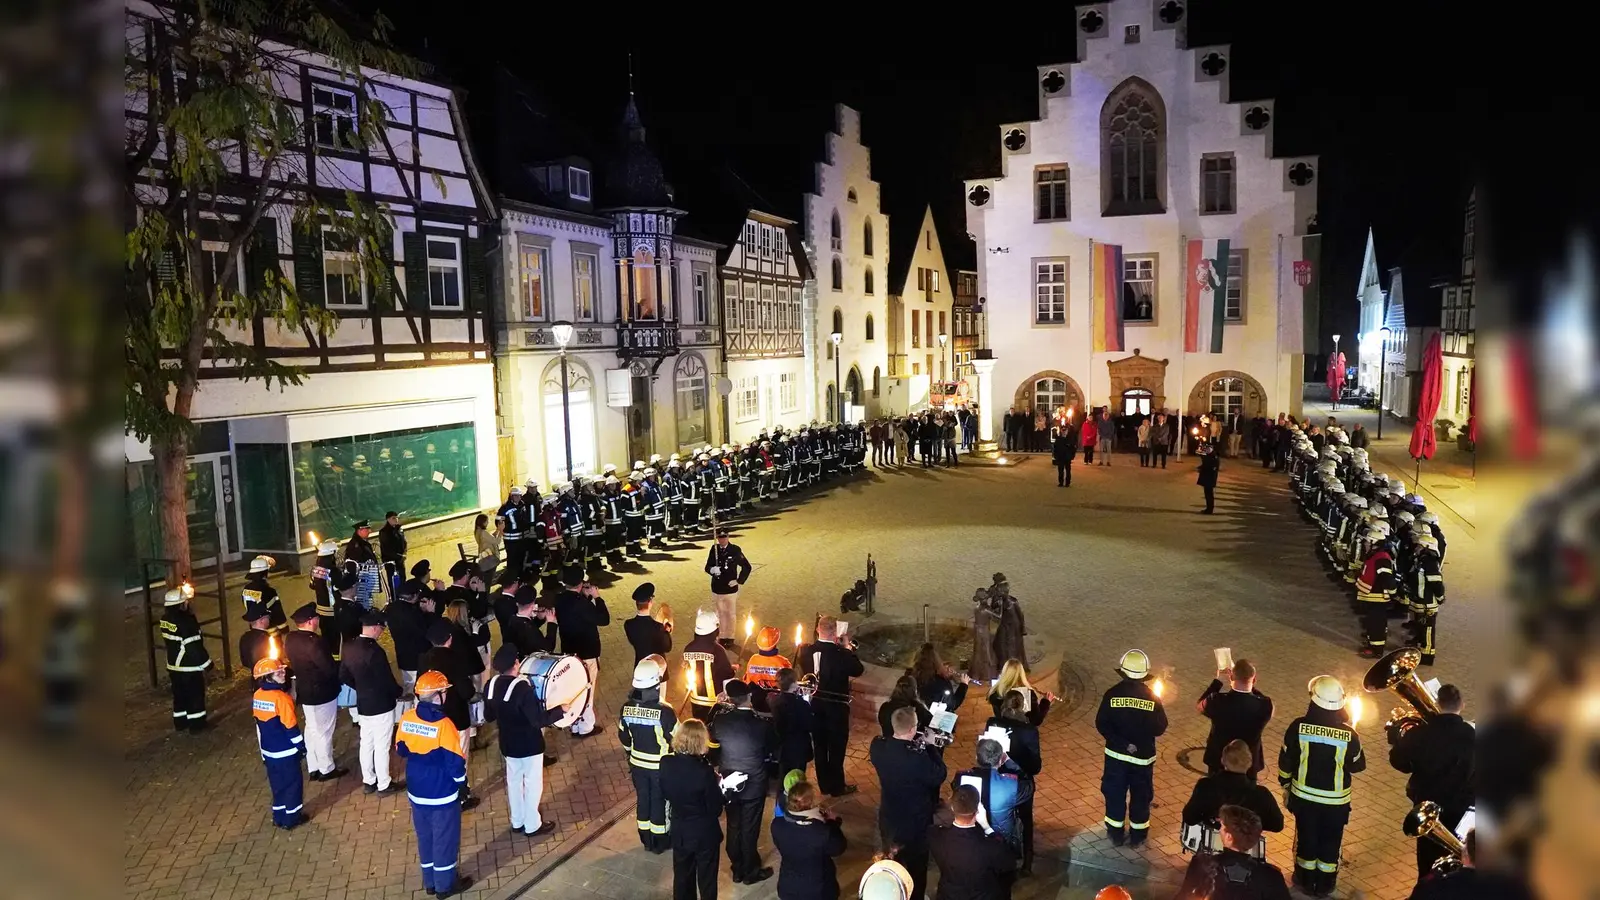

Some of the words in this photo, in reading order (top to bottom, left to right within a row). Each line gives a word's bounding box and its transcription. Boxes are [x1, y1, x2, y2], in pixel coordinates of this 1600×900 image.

[684, 652, 714, 660] FEUERWEHR
[1111, 698, 1153, 710] FEUERWEHR
[624, 707, 660, 719] FEUERWEHR
[1301, 724, 1350, 741] FEUERWEHR
